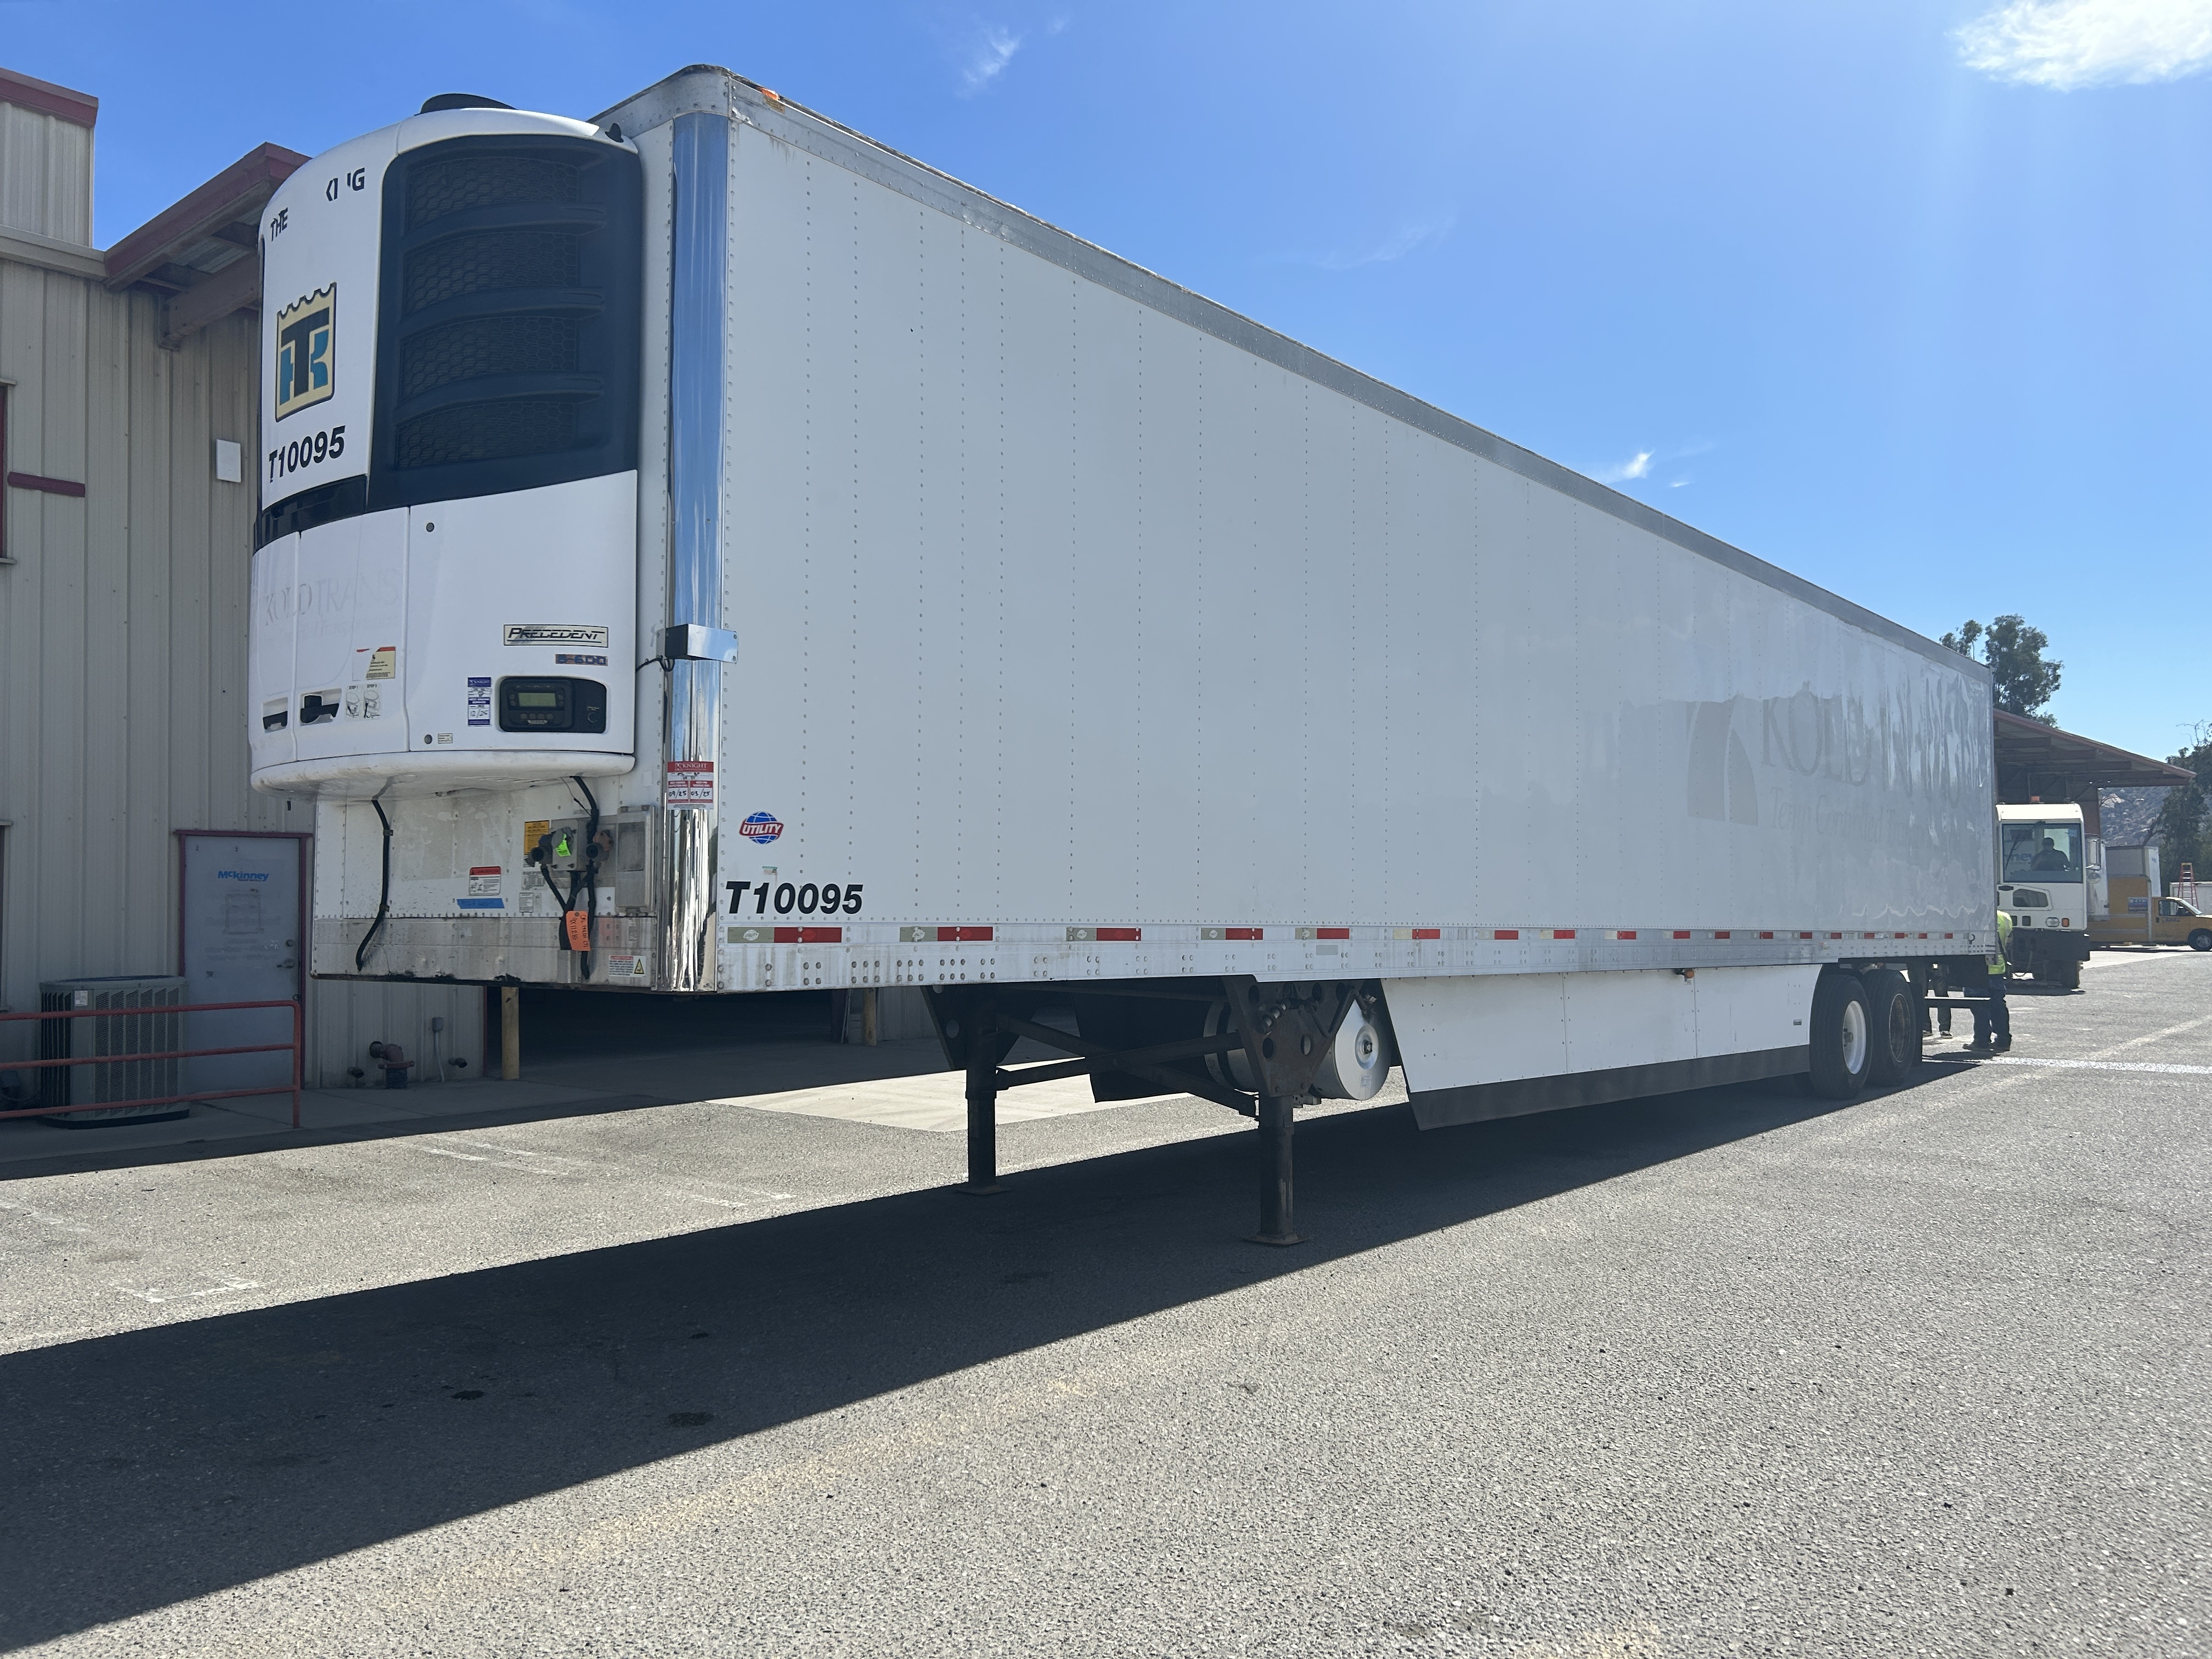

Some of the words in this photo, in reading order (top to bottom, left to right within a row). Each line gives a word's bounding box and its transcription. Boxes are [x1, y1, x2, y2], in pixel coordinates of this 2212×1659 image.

[269, 425, 346, 483] T10095
[508, 628, 605, 640] PRECEDENT
[742, 823, 782, 835] UTILITY
[725, 881, 864, 915] T10095
